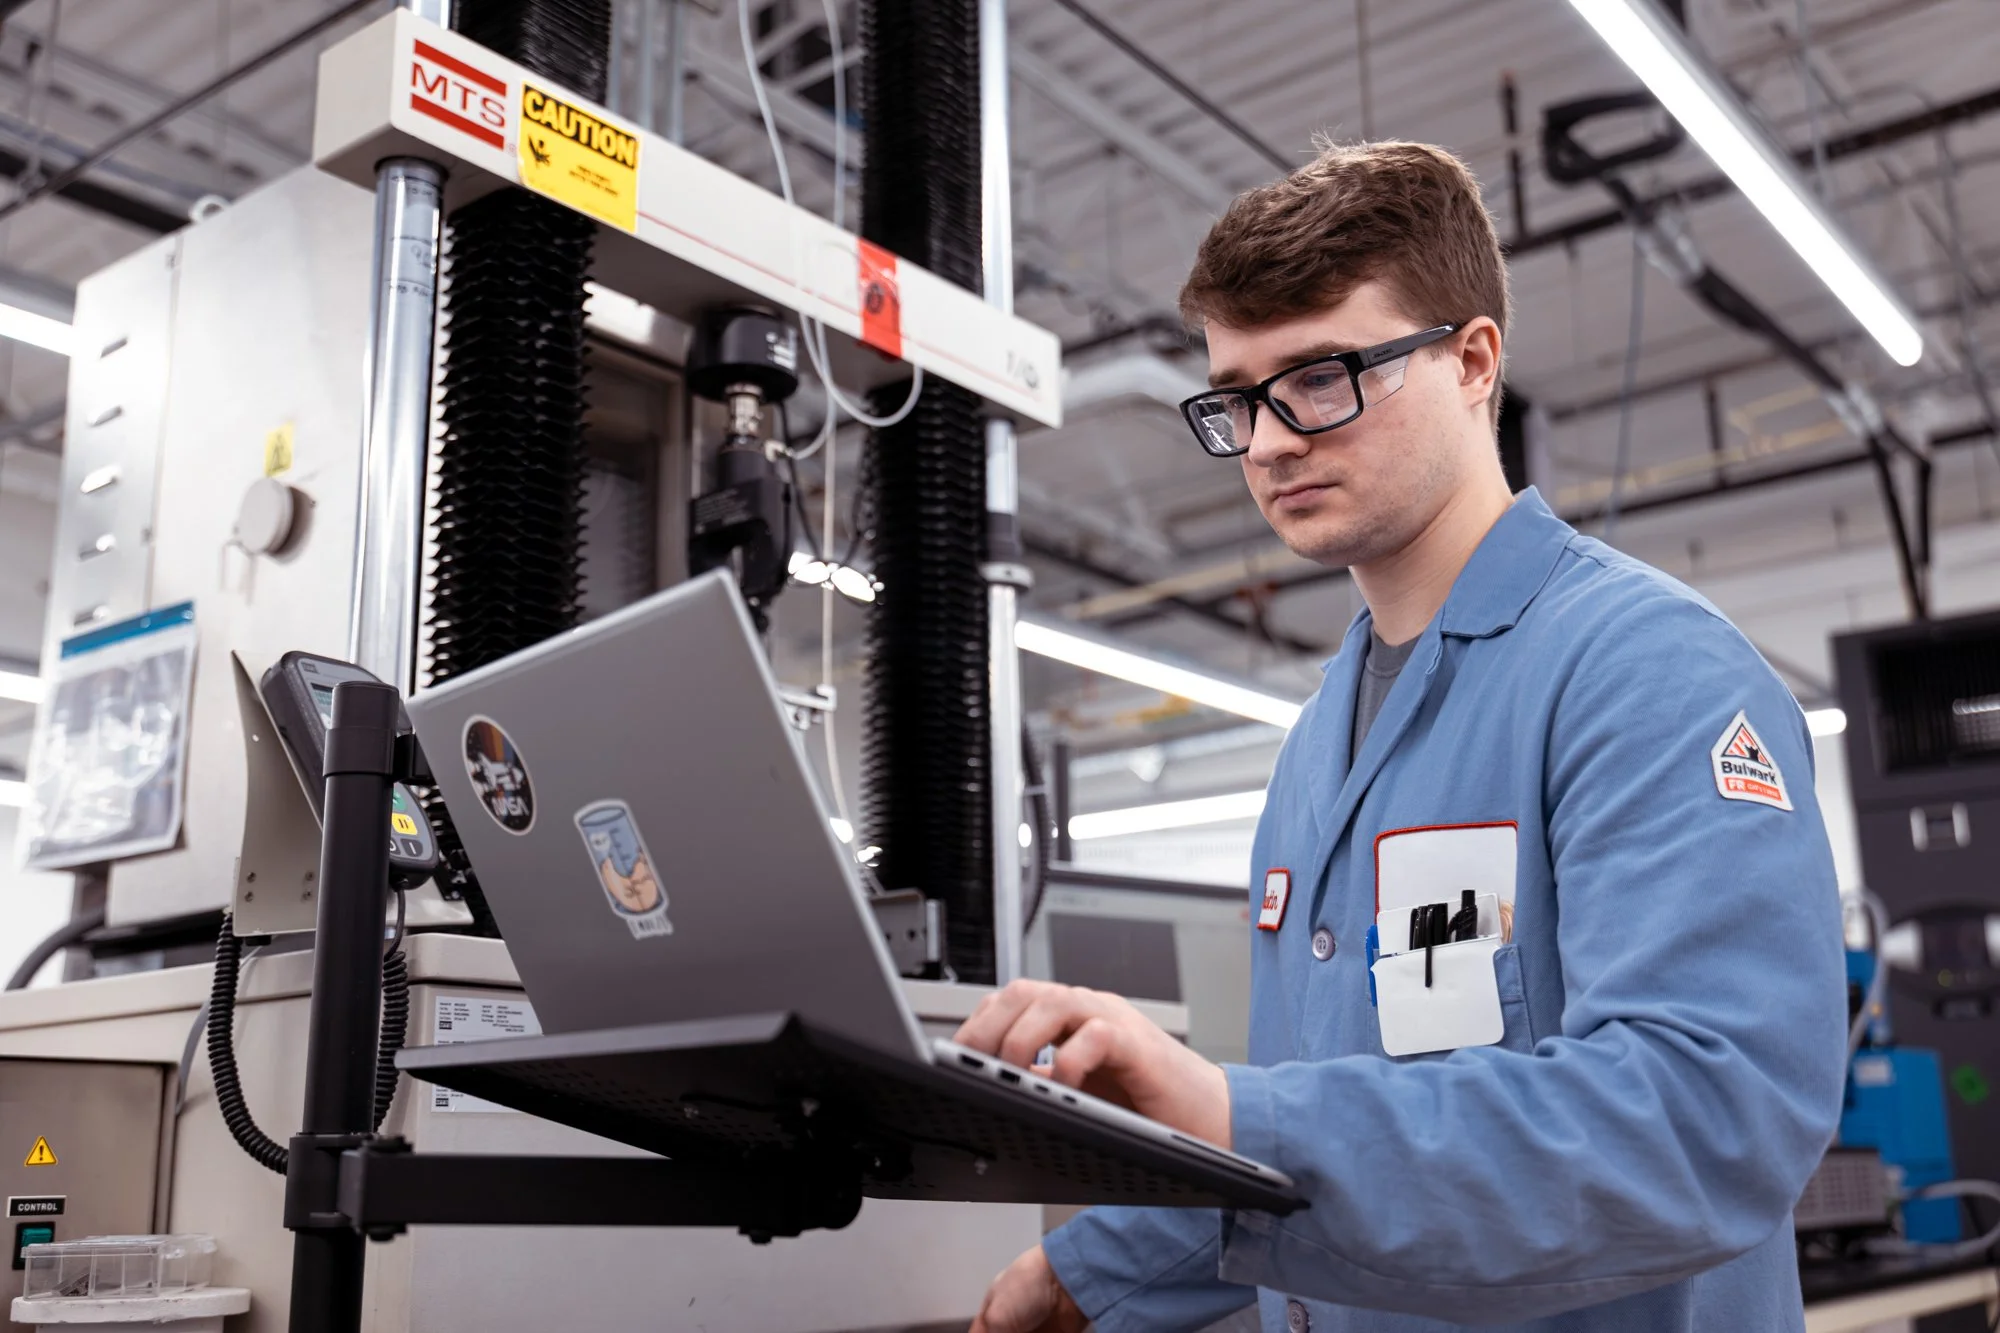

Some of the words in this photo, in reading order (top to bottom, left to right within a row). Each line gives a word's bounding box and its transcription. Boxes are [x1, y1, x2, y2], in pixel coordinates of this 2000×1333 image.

[411, 62, 506, 128] MTS
[523, 89, 638, 168] CAUTION
[1721, 761, 1777, 785] Bulwark
[1728, 778, 1746, 791] FR
[18, 1202, 57, 1212] CONTROL
